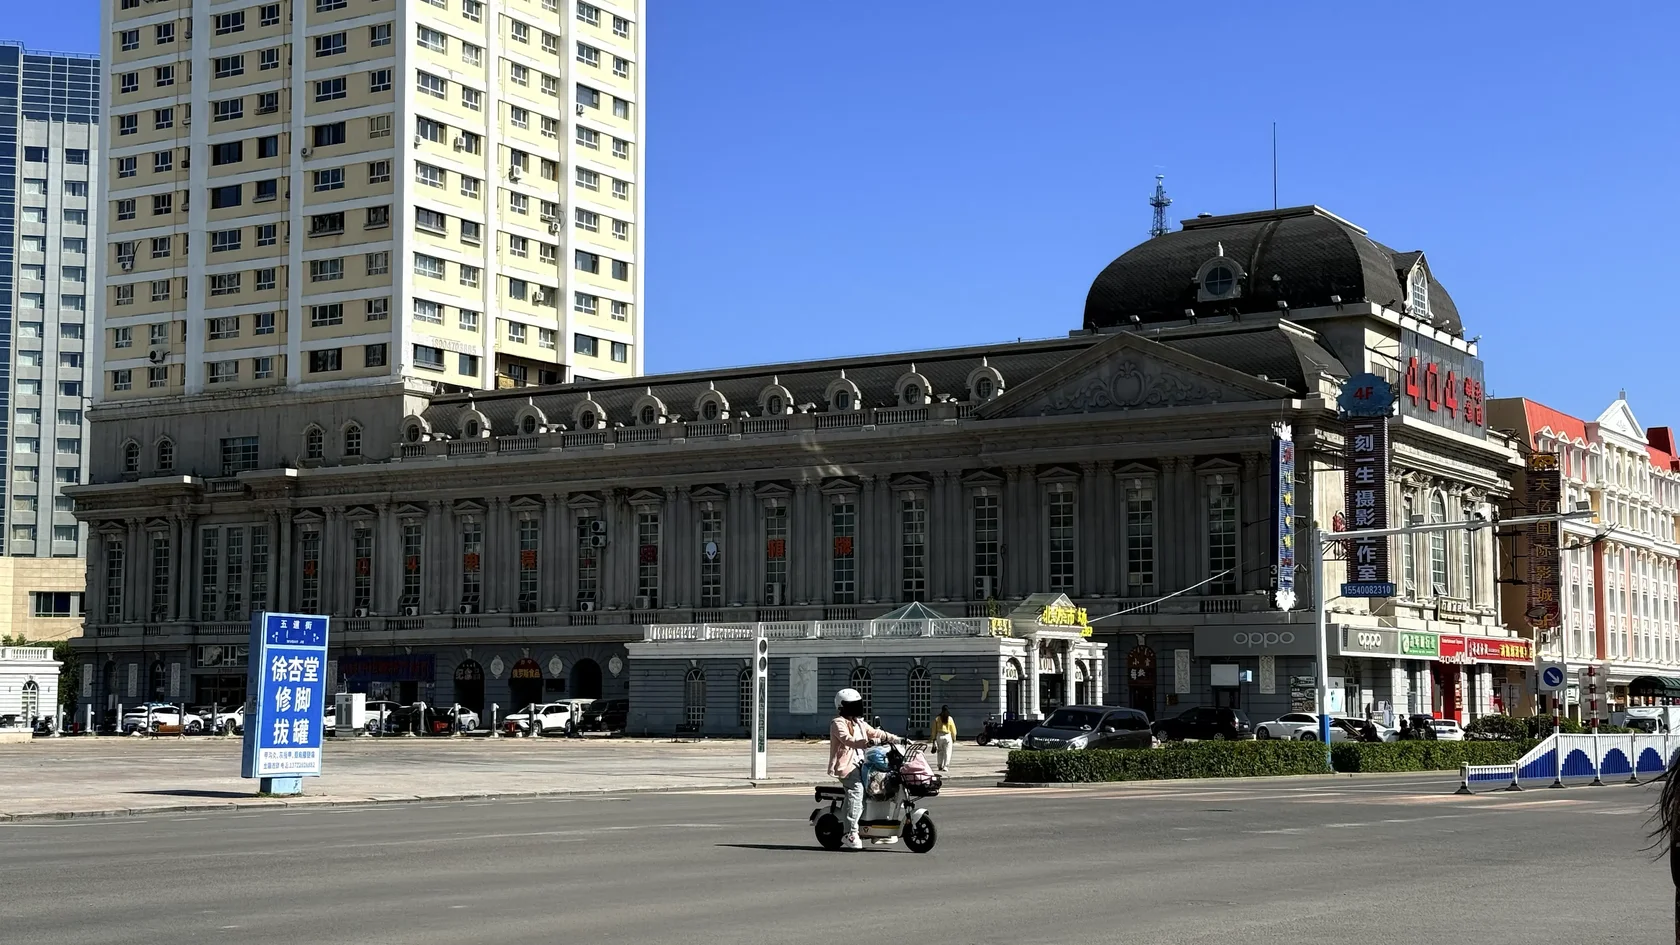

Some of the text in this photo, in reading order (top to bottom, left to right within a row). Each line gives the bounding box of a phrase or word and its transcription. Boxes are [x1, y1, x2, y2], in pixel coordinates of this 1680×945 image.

[1354, 386, 1374, 400] 4F
[1406, 357, 1458, 419] 404
[1535, 478, 1552, 602] 天亿国际影城
[1344, 585, 1391, 595] 15540082310
[280, 619, 313, 631] 五道街
[271, 655, 319, 682] 徐杏堂
[512, 668, 541, 679] 俄罗斯食品
[275, 686, 312, 713] 修脚
[273, 718, 310, 745] 拔罐
